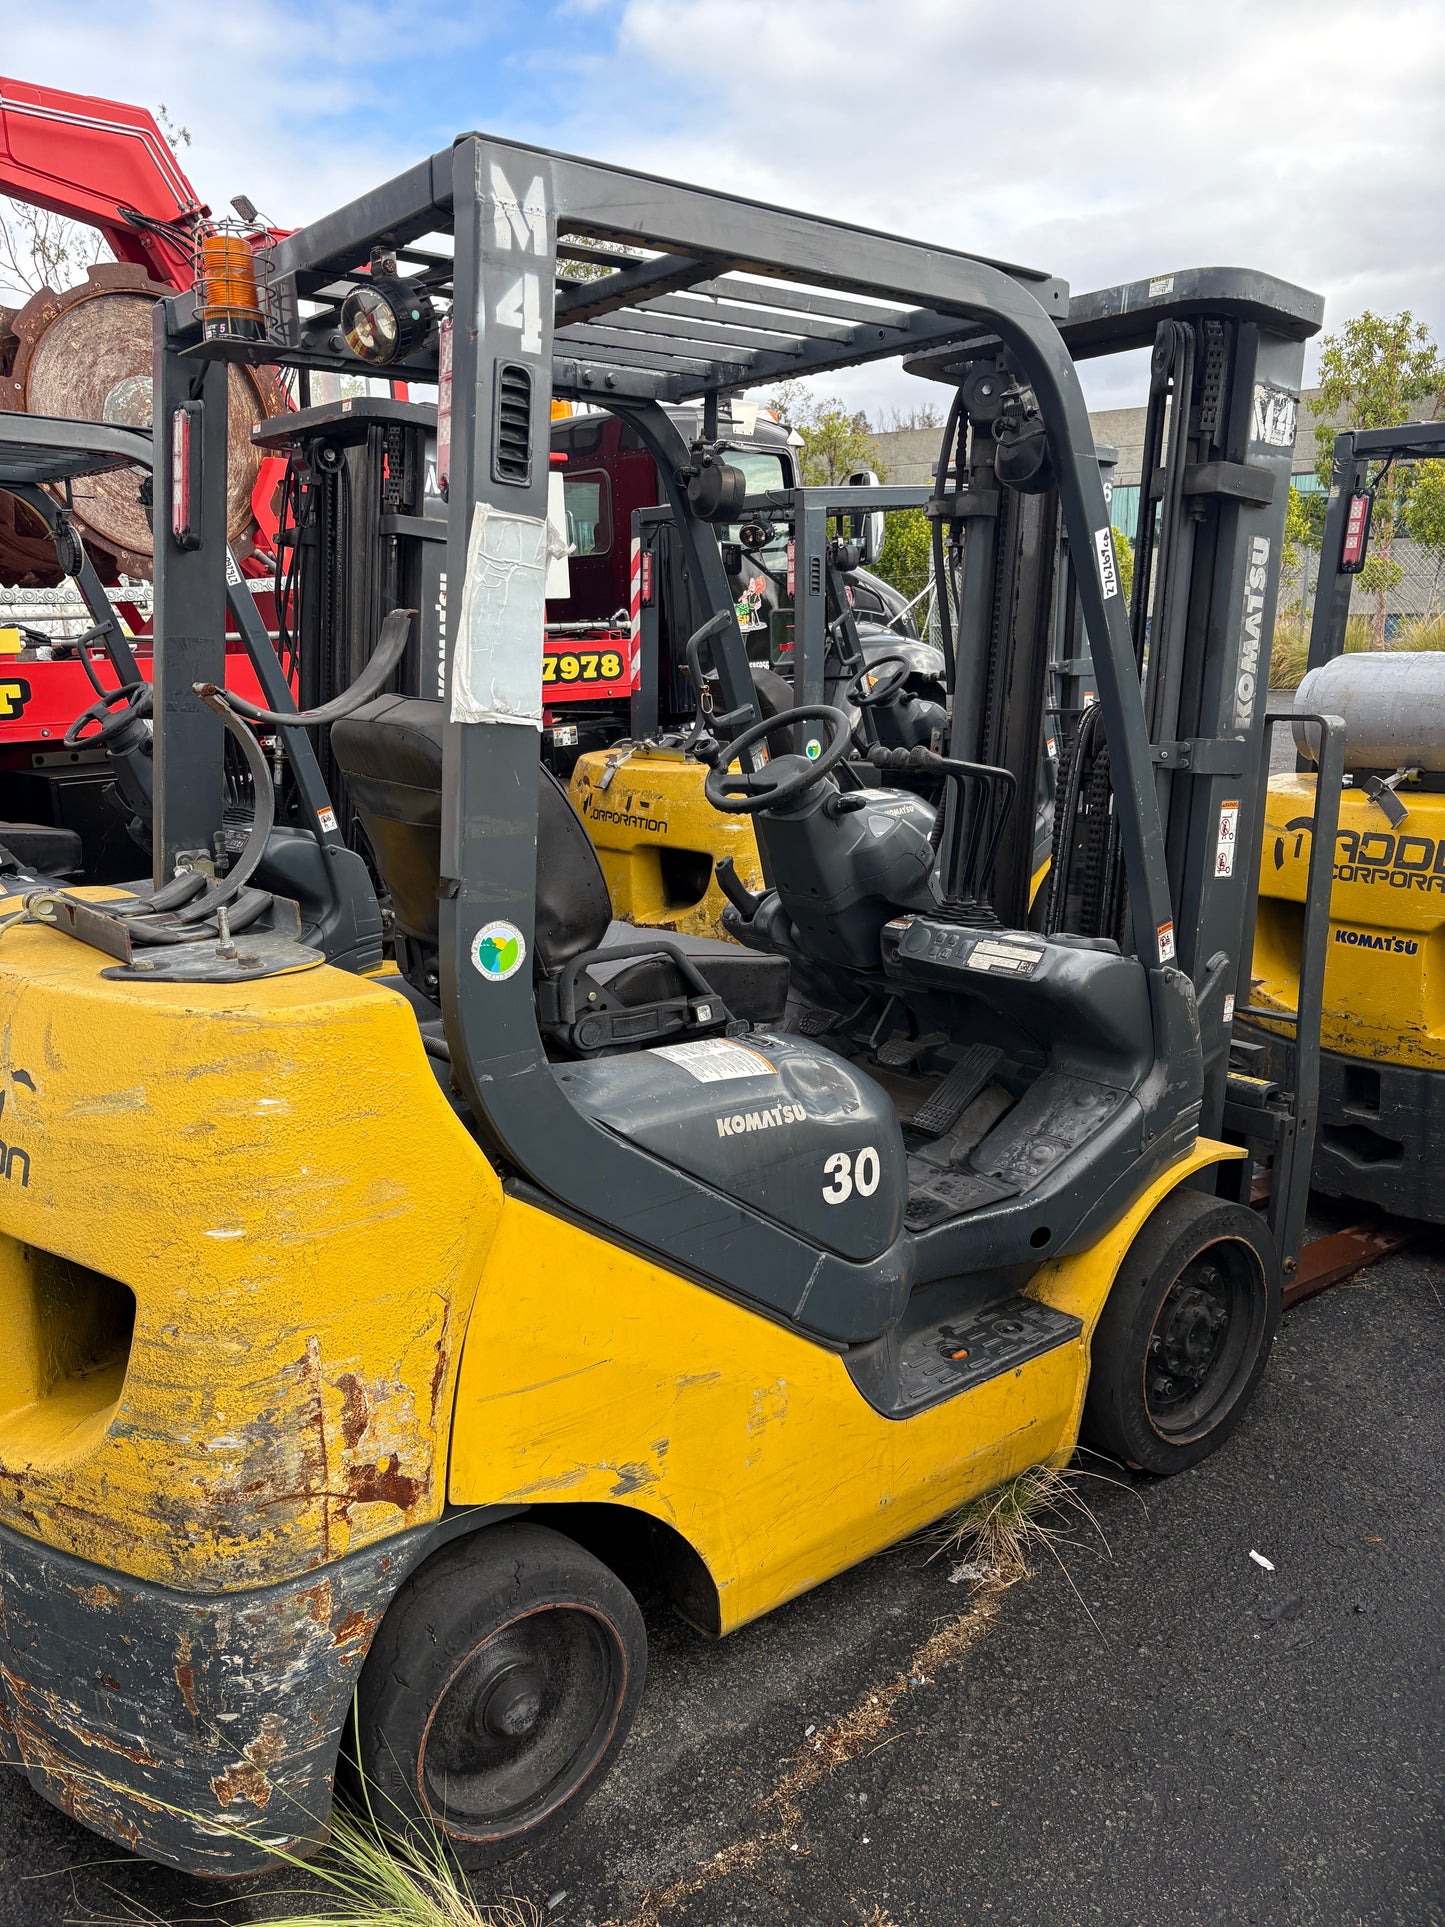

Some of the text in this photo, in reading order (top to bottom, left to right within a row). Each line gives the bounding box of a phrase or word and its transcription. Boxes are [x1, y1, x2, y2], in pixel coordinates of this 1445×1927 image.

[1234, 537, 1270, 729] KOMATSU
[590, 808, 668, 834] ORPORATION
[1335, 929, 1418, 955] KOMATSU
[715, 1103, 807, 1138] KOMATSU
[822, 1146, 881, 1205] 30
